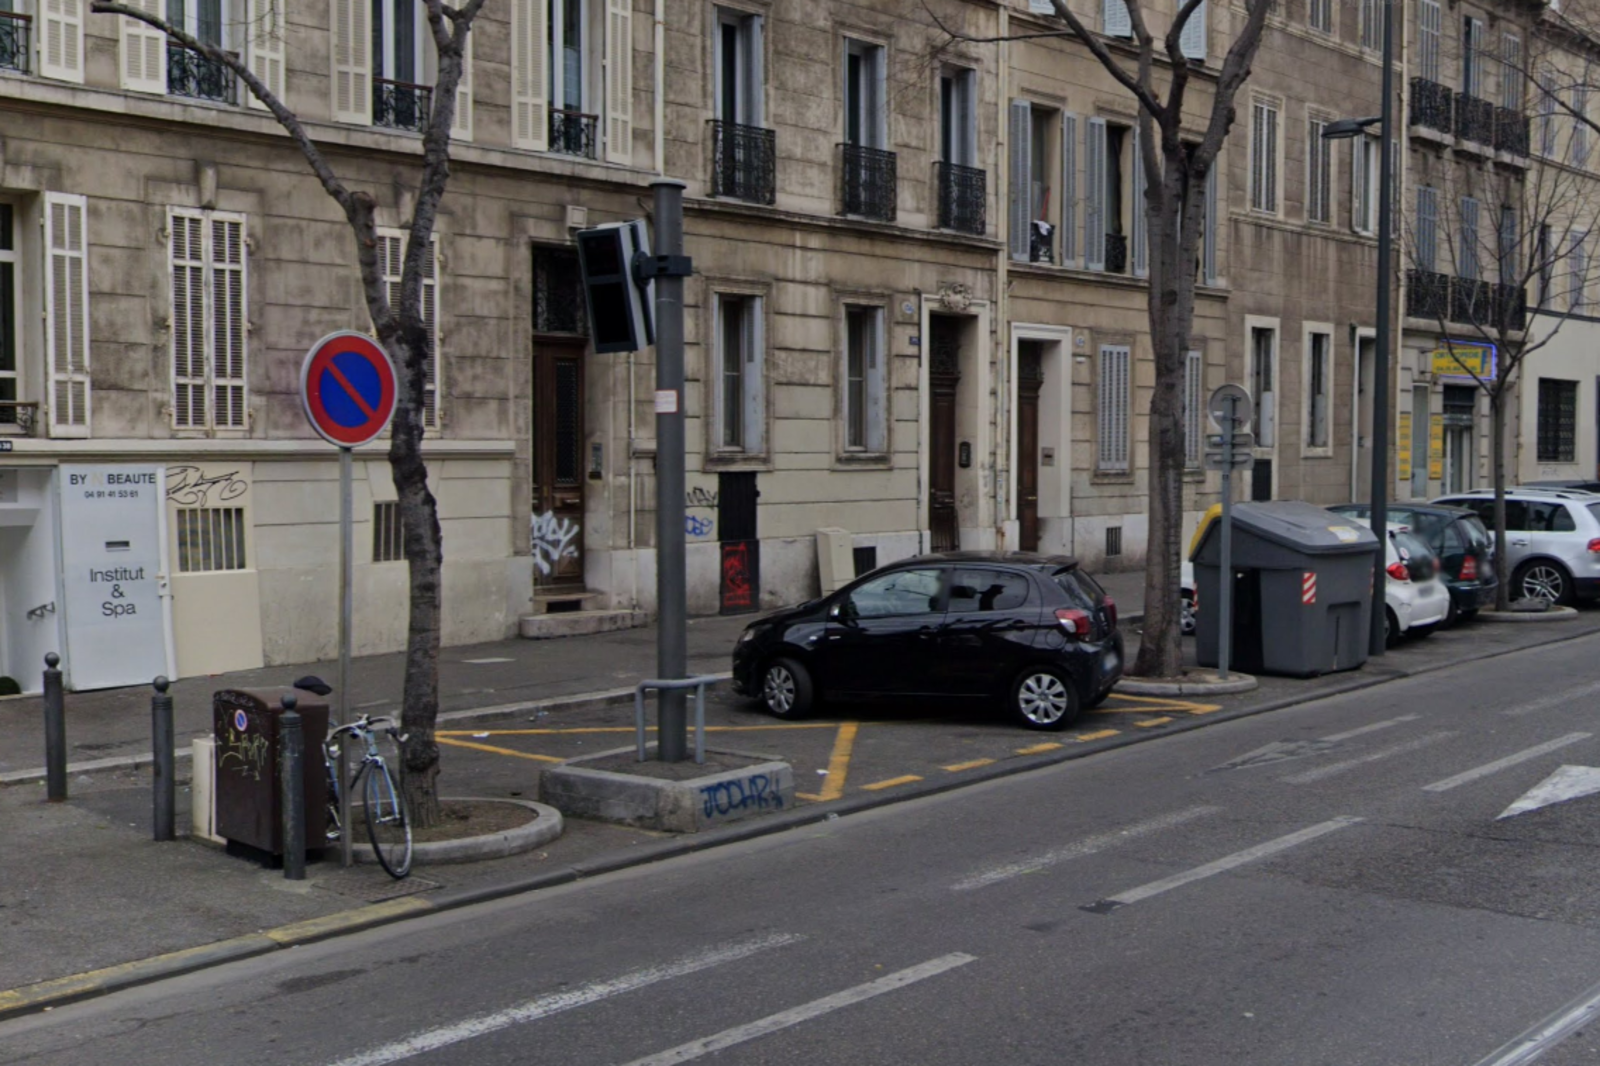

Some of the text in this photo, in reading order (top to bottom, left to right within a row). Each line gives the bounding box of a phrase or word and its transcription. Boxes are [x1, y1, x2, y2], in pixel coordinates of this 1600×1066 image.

[70, 474, 87, 485] BY
[107, 473, 156, 484] BEAUTE
[90, 566, 145, 582] Institut
[111, 584, 125, 598] &
[102, 601, 137, 618] Spa
